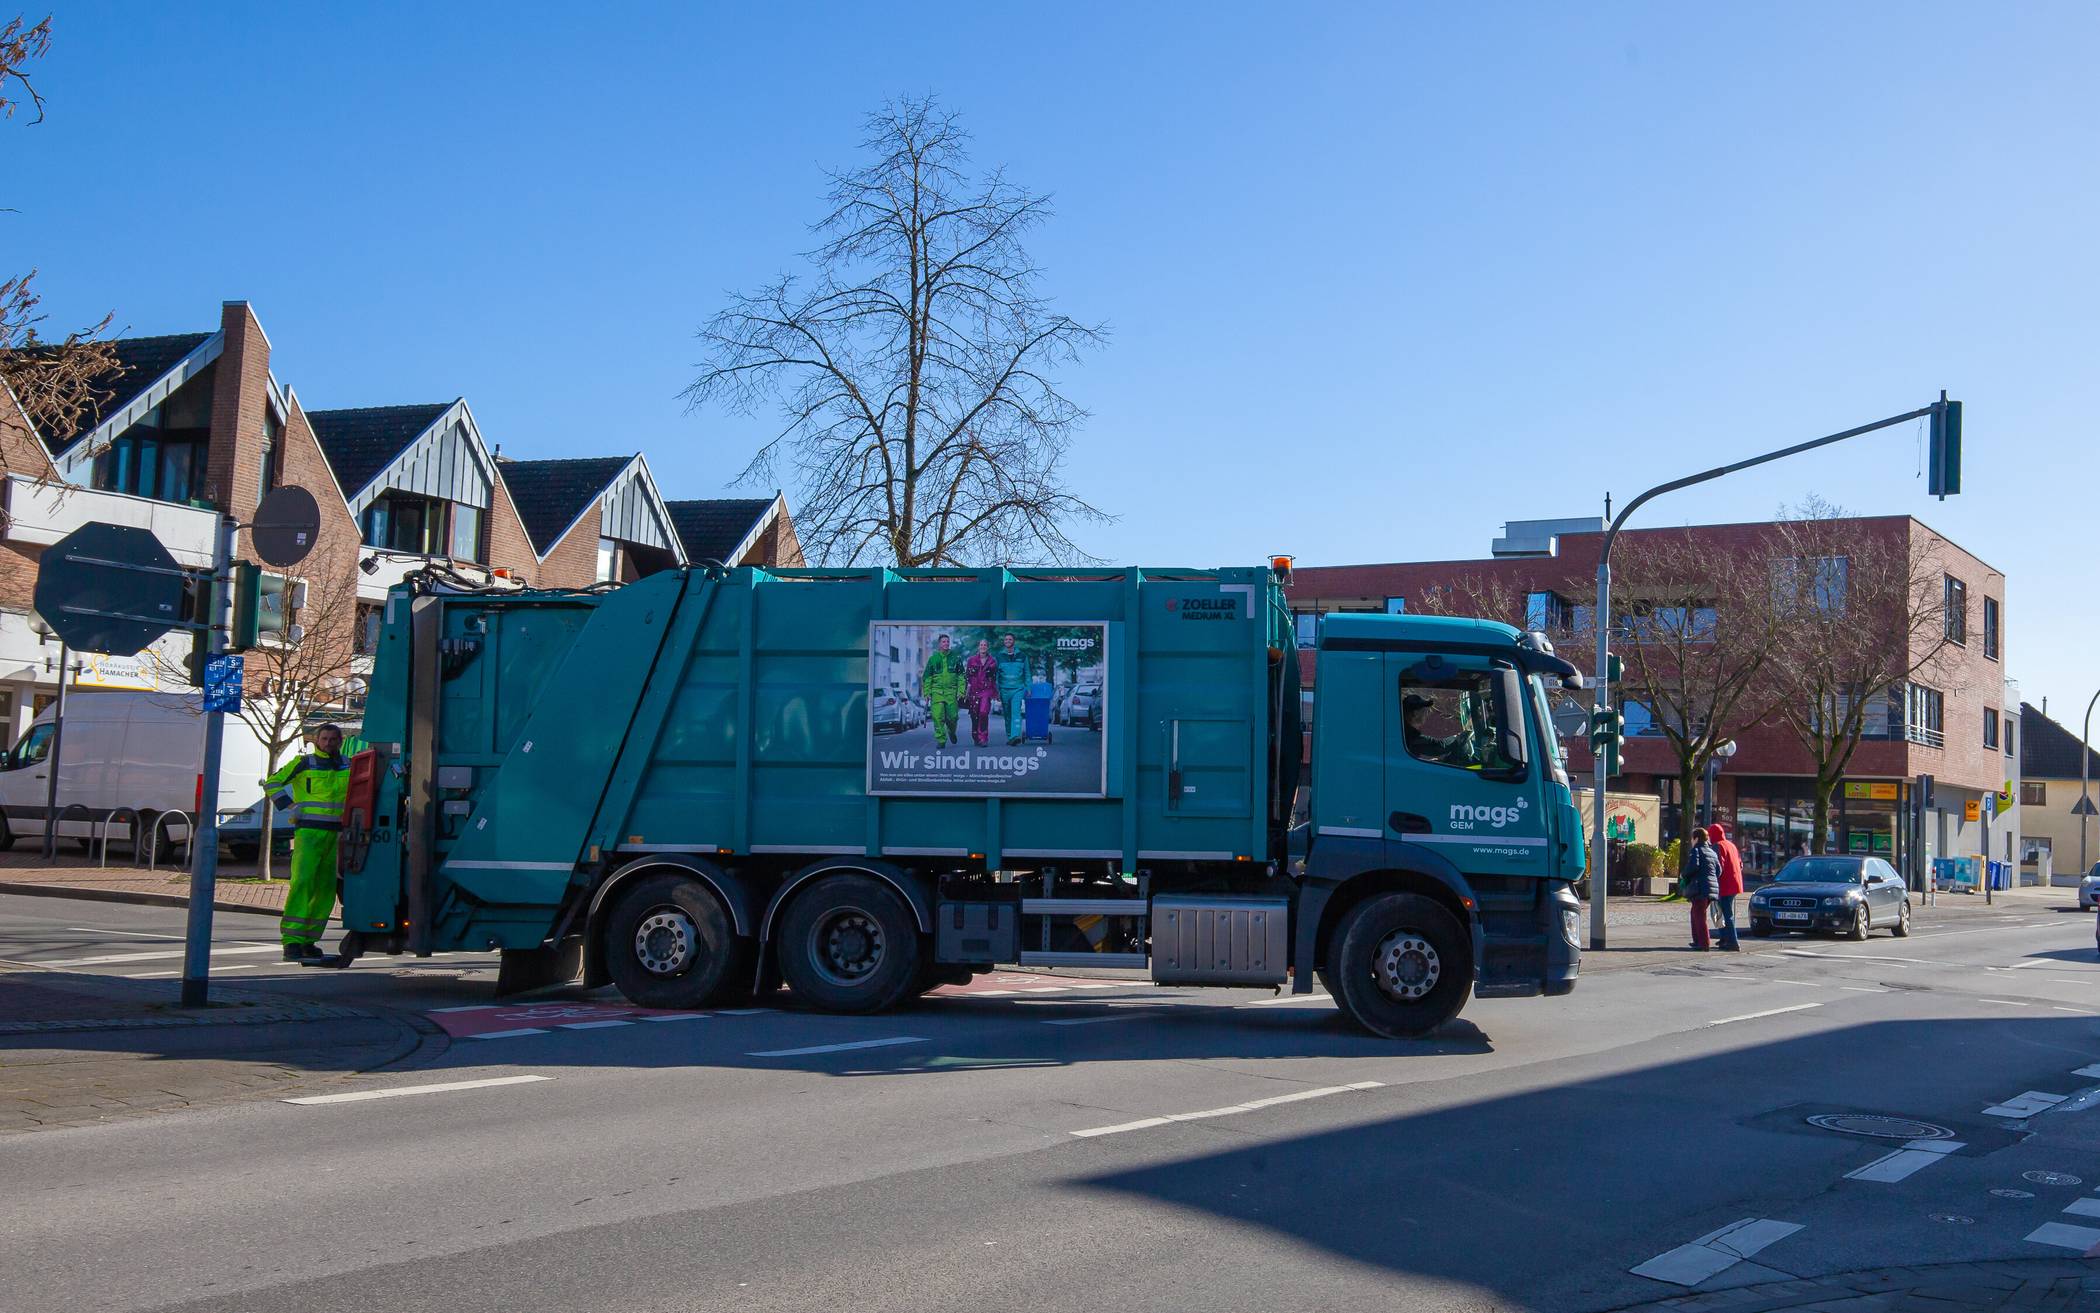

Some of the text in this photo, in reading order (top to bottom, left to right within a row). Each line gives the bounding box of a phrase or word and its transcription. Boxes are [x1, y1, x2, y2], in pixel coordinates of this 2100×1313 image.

[1182, 599, 1236, 610] ZOELLER
[1182, 612, 1235, 620] MEDIUM XL
[1057, 638, 1094, 650] mags
[880, 750, 1040, 776] Wir sind mags
[1450, 804, 1520, 828] mags
[1450, 821, 1474, 830] GEM
[1473, 847, 1529, 856] www.mags.de
